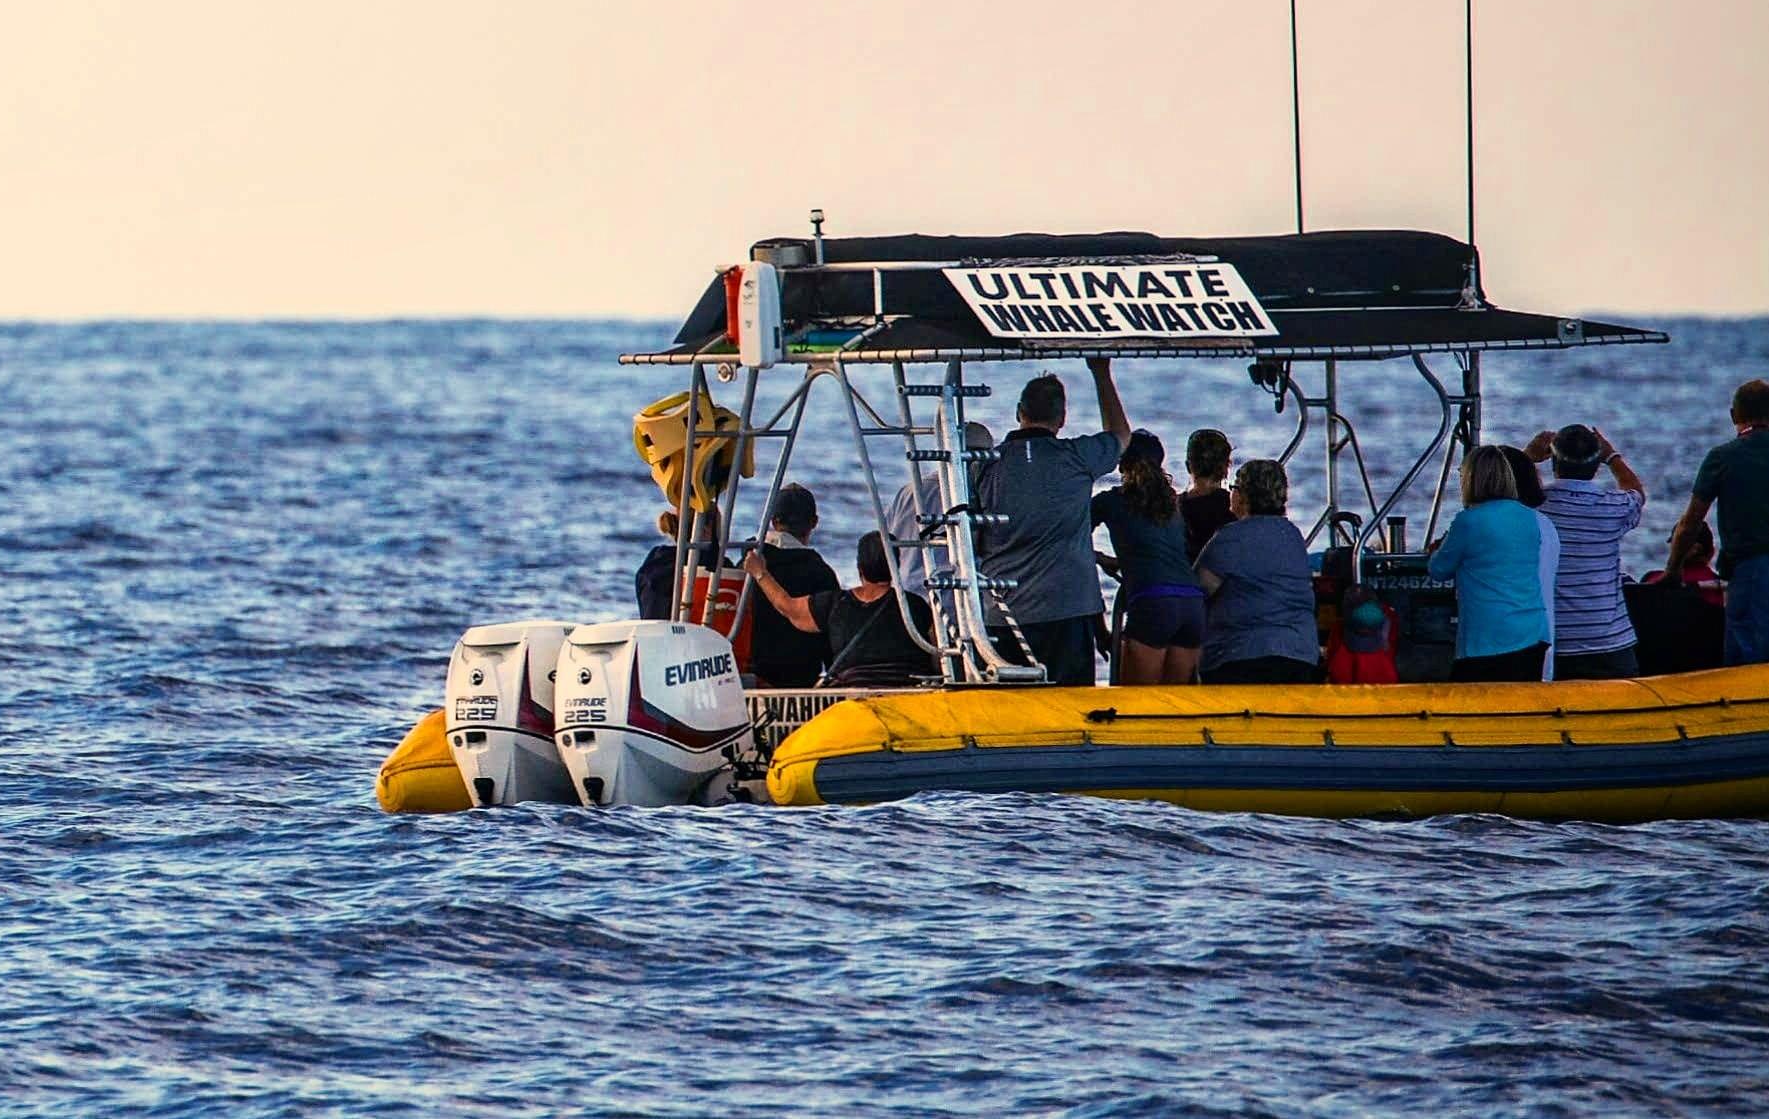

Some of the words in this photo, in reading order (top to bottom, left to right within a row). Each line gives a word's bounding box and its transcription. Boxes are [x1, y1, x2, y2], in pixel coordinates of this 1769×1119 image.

[966, 268, 1230, 300] ULTIMATE
[979, 303, 1116, 333] WHALE
[1113, 301, 1266, 331] WATCH
[664, 652, 733, 686] EVINRUDE
[455, 708, 498, 721] 225
[564, 709, 607, 723] 225
